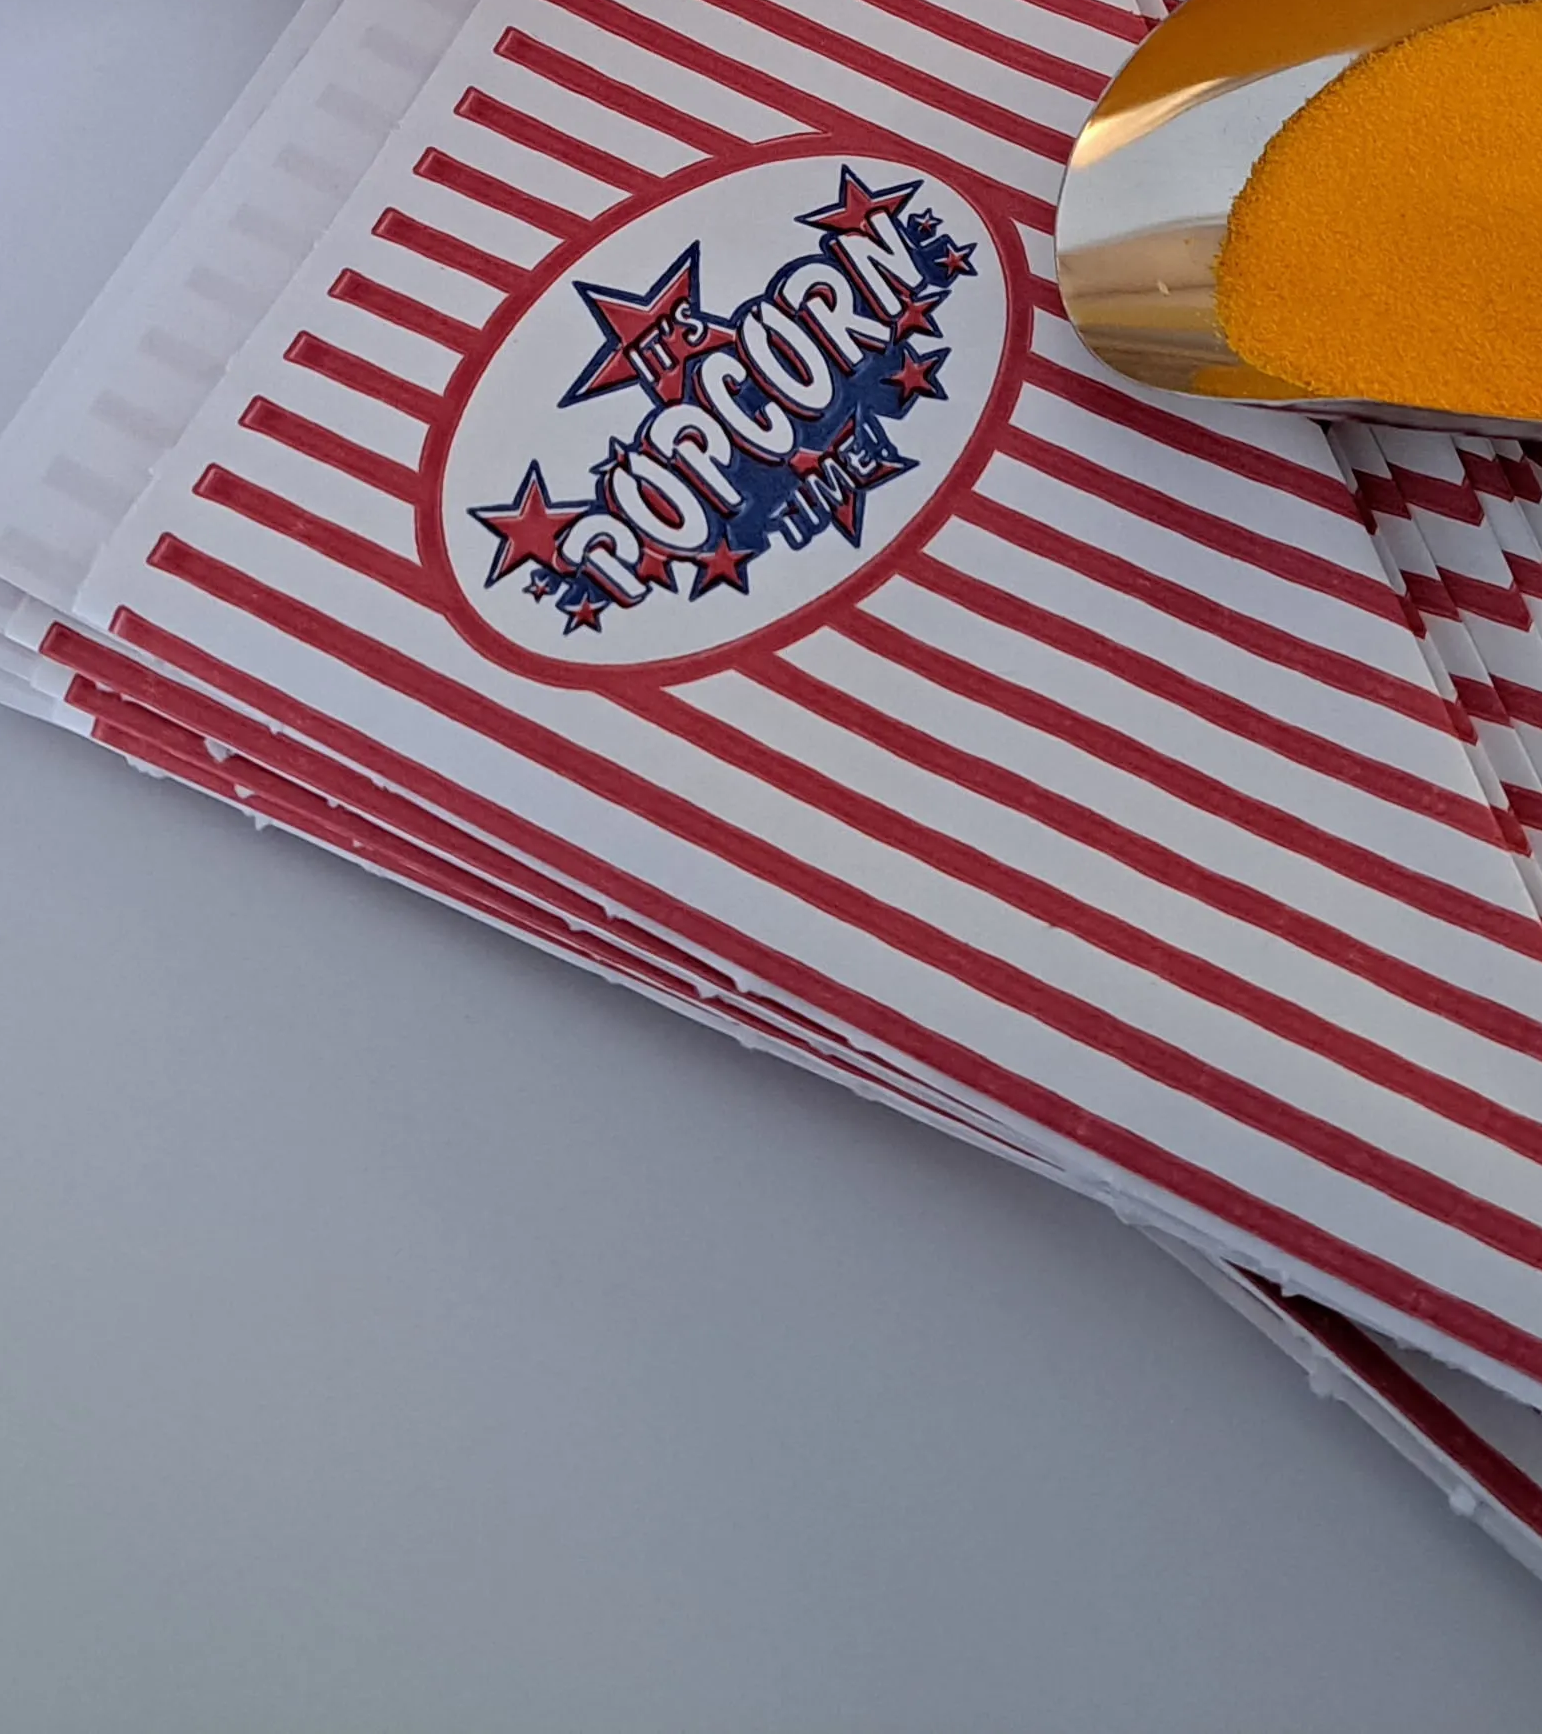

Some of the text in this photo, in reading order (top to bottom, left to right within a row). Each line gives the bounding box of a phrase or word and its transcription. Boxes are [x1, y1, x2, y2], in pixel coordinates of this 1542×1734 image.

[623, 298, 705, 384] IT'S
[559, 207, 929, 608] POPCORN
[771, 420, 899, 550] TIME!
